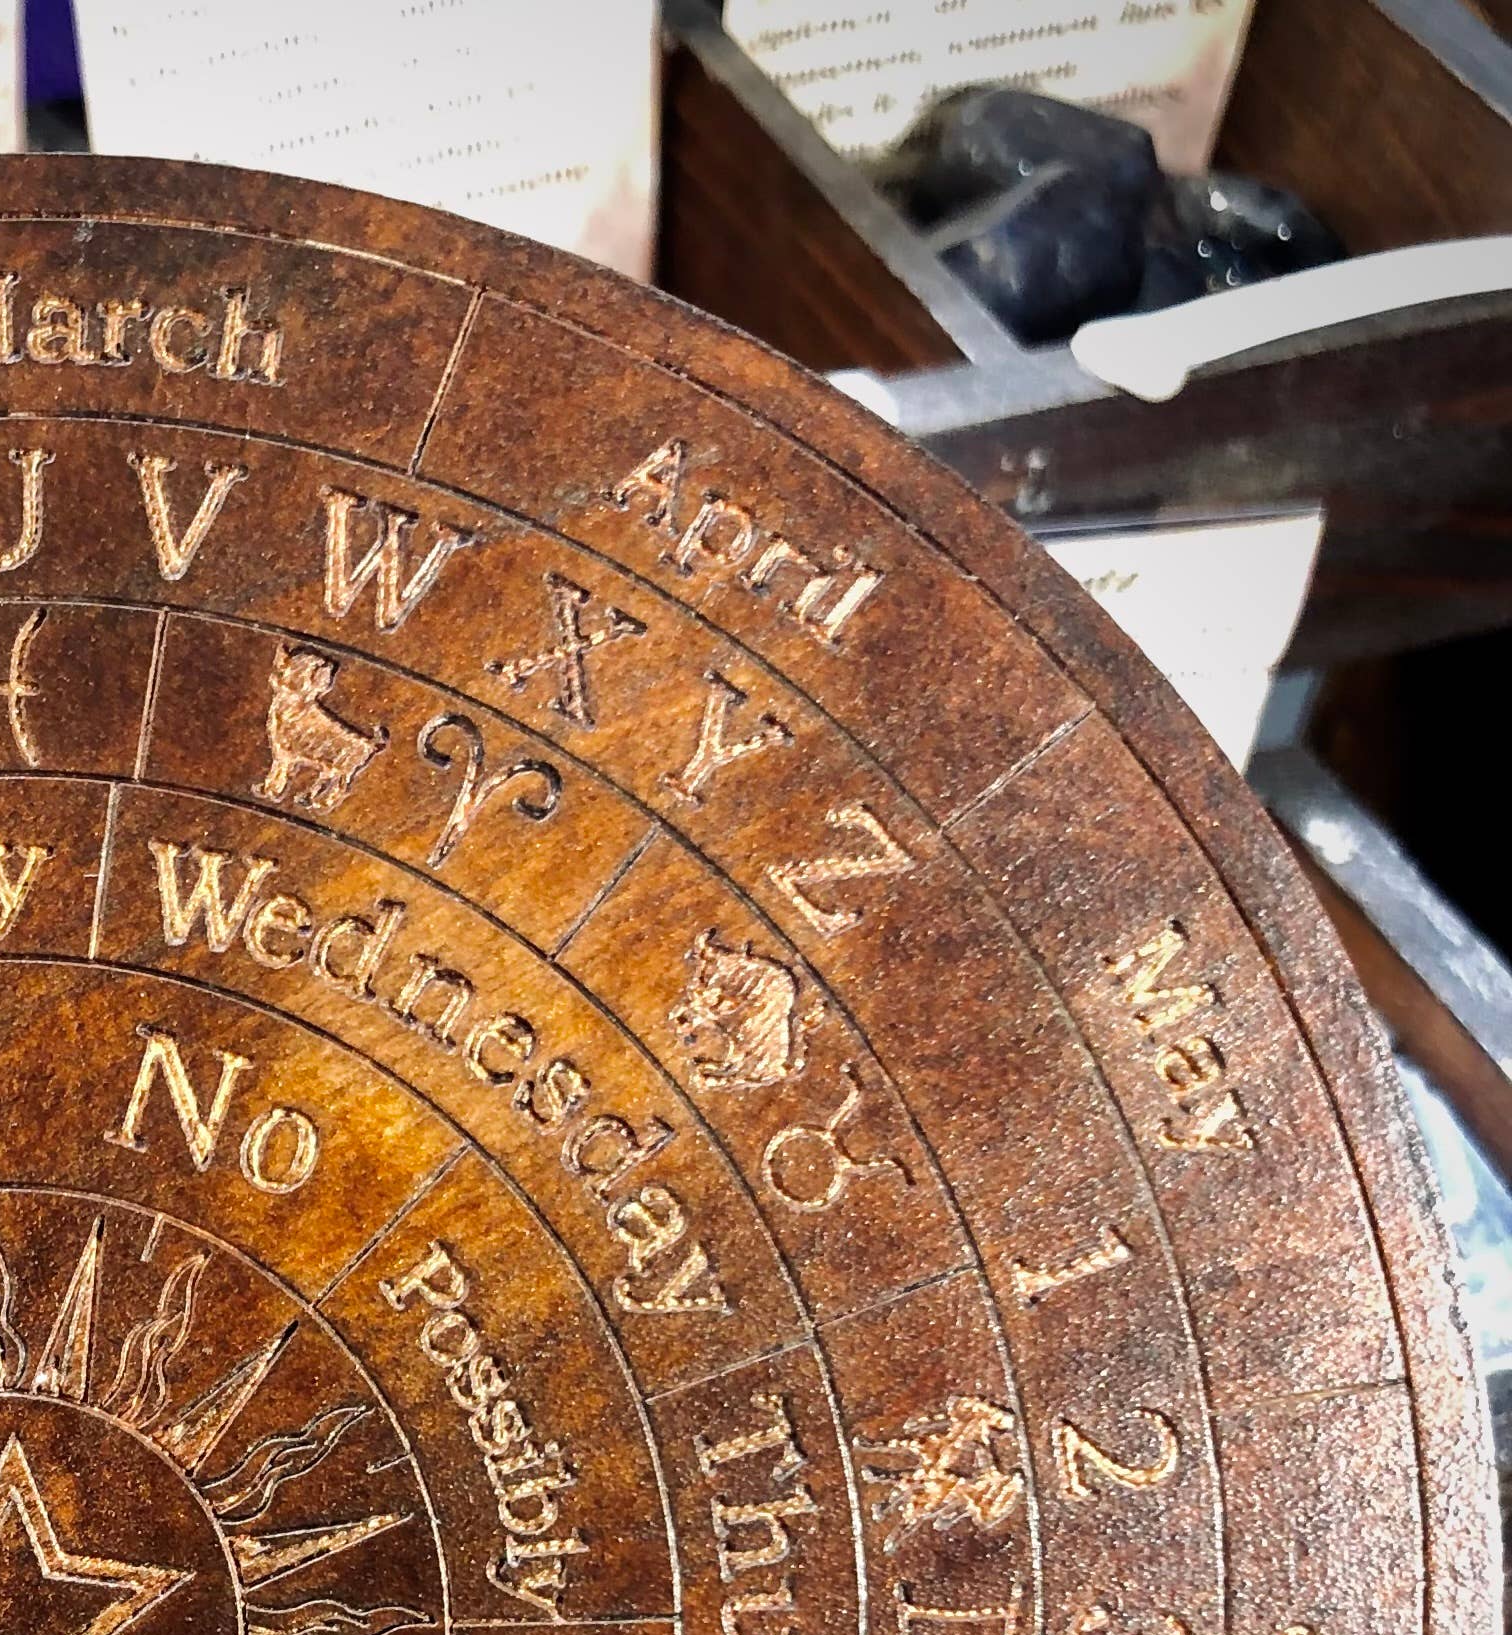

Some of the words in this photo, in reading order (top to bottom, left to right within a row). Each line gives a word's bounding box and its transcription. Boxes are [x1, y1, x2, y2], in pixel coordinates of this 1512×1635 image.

[600, 437, 886, 650] April
[127, 450, 250, 582] V
[319, 484, 478, 635] W
[484, 570, 649, 730] X
[658, 667, 796, 811] Y
[764, 801, 917, 937] Z
[103, 1023, 321, 1194] No
[147, 838, 735, 1317] Wednesday
[1103, 917, 1257, 1152] May
[1011, 1223, 1135, 1307] 1
[380, 1239, 589, 1620] Possibly
[1052, 1406, 1180, 1499] 2
